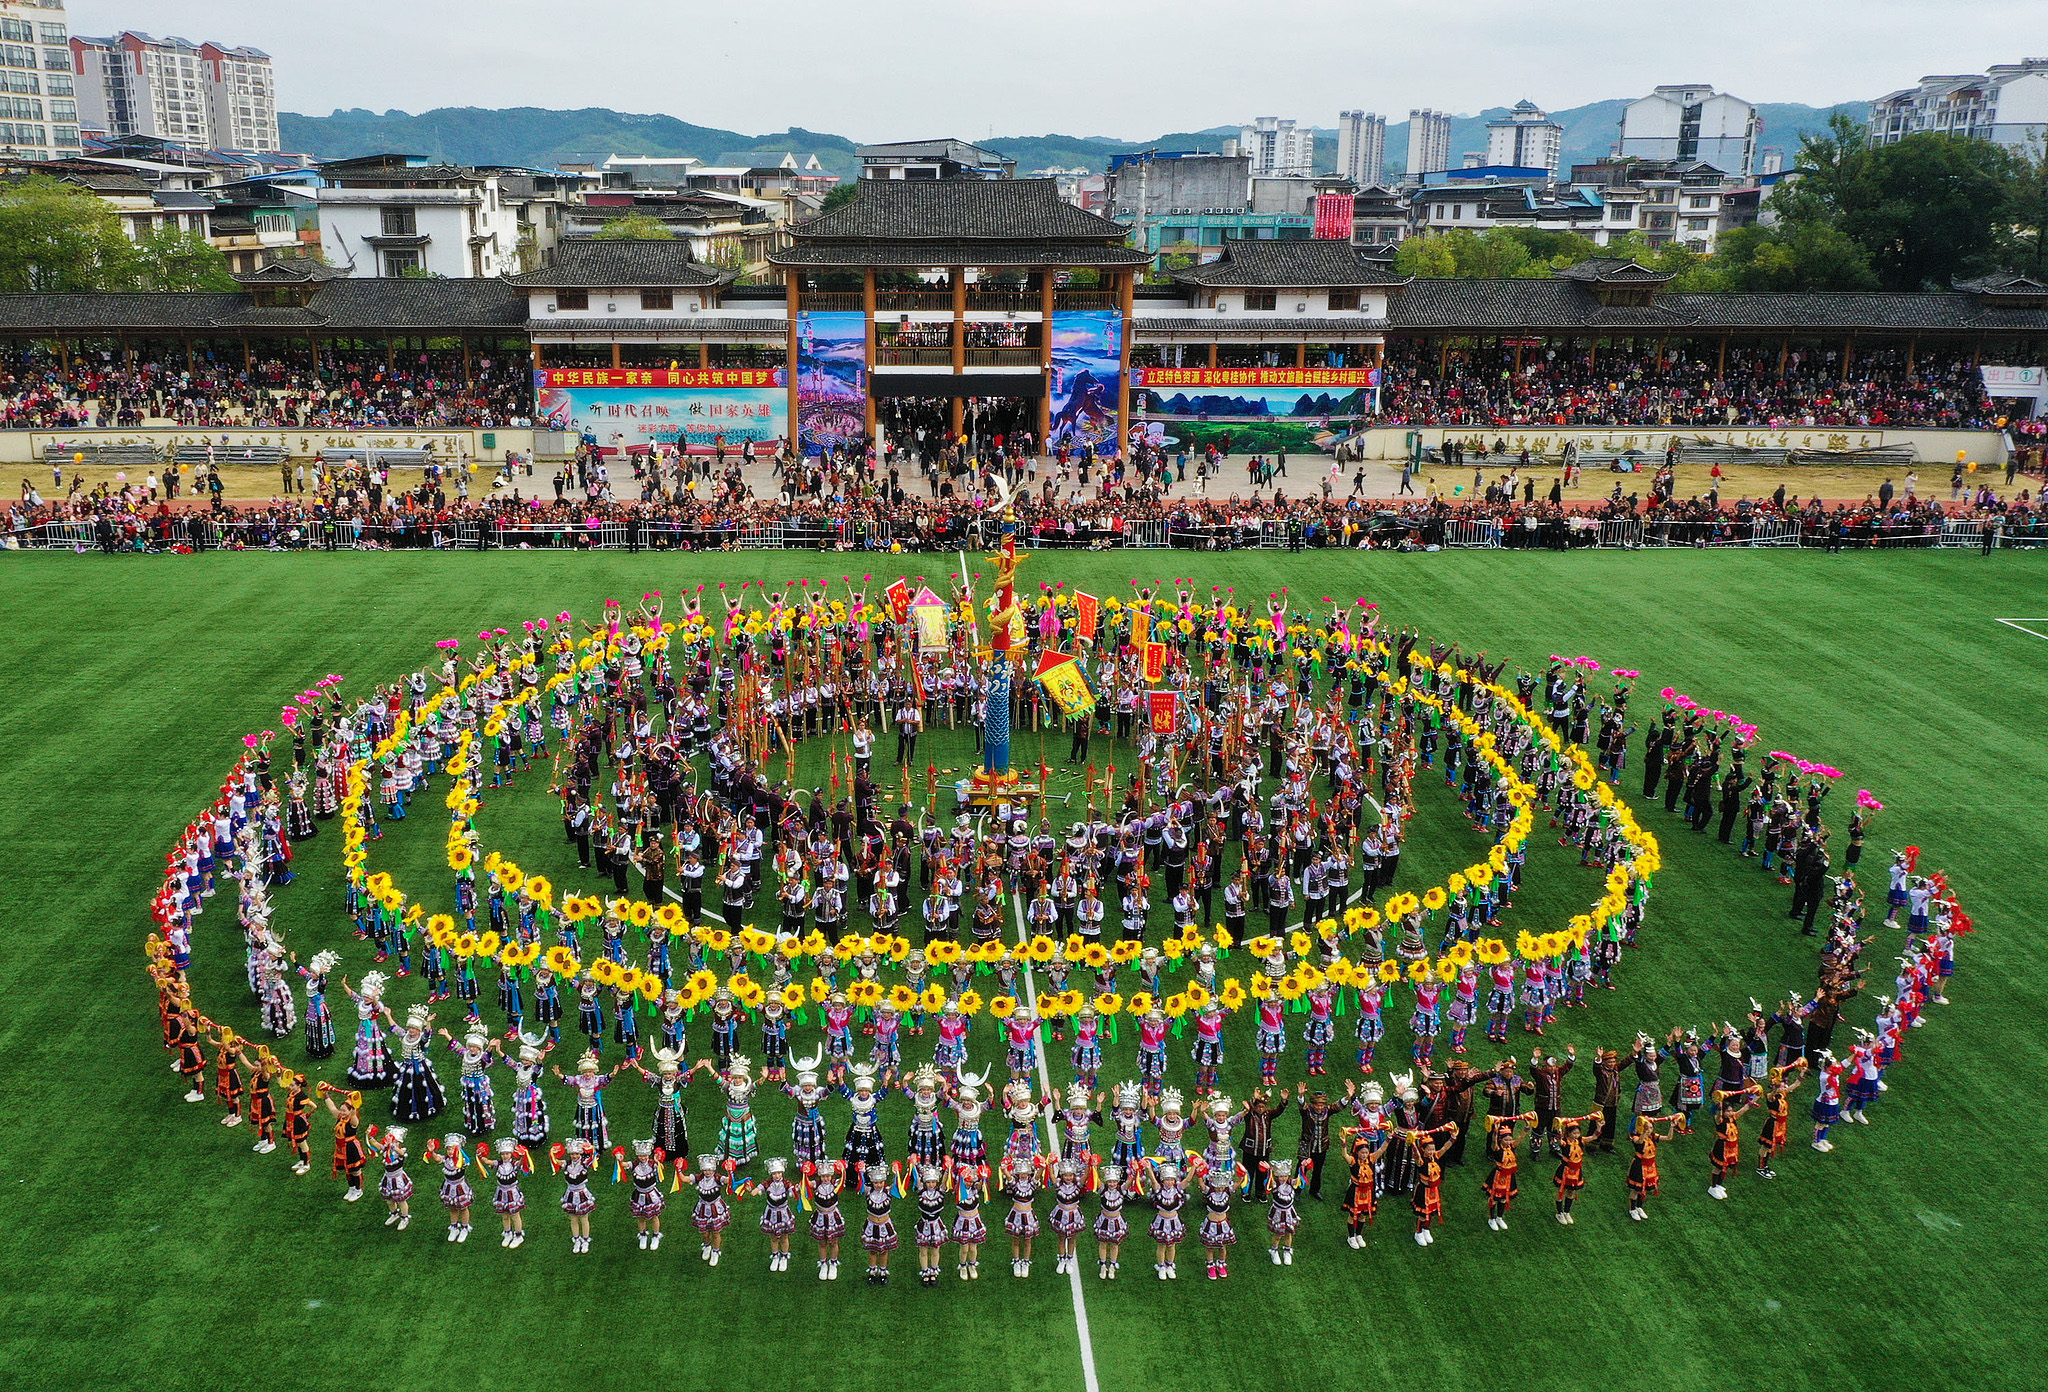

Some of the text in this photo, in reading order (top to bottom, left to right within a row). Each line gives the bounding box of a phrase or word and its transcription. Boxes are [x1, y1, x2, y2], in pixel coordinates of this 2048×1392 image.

[552, 371, 768, 385] 中华民族一家亲 同心共筑中国梦
[1147, 370, 1366, 384] 立足特色资源 深化粤桂协作 推动文旅融合赋能乡村振兴
[1987, 369, 2016, 381] 出口
[589, 401, 772, 418] 听时代召唤 做国家英雄
